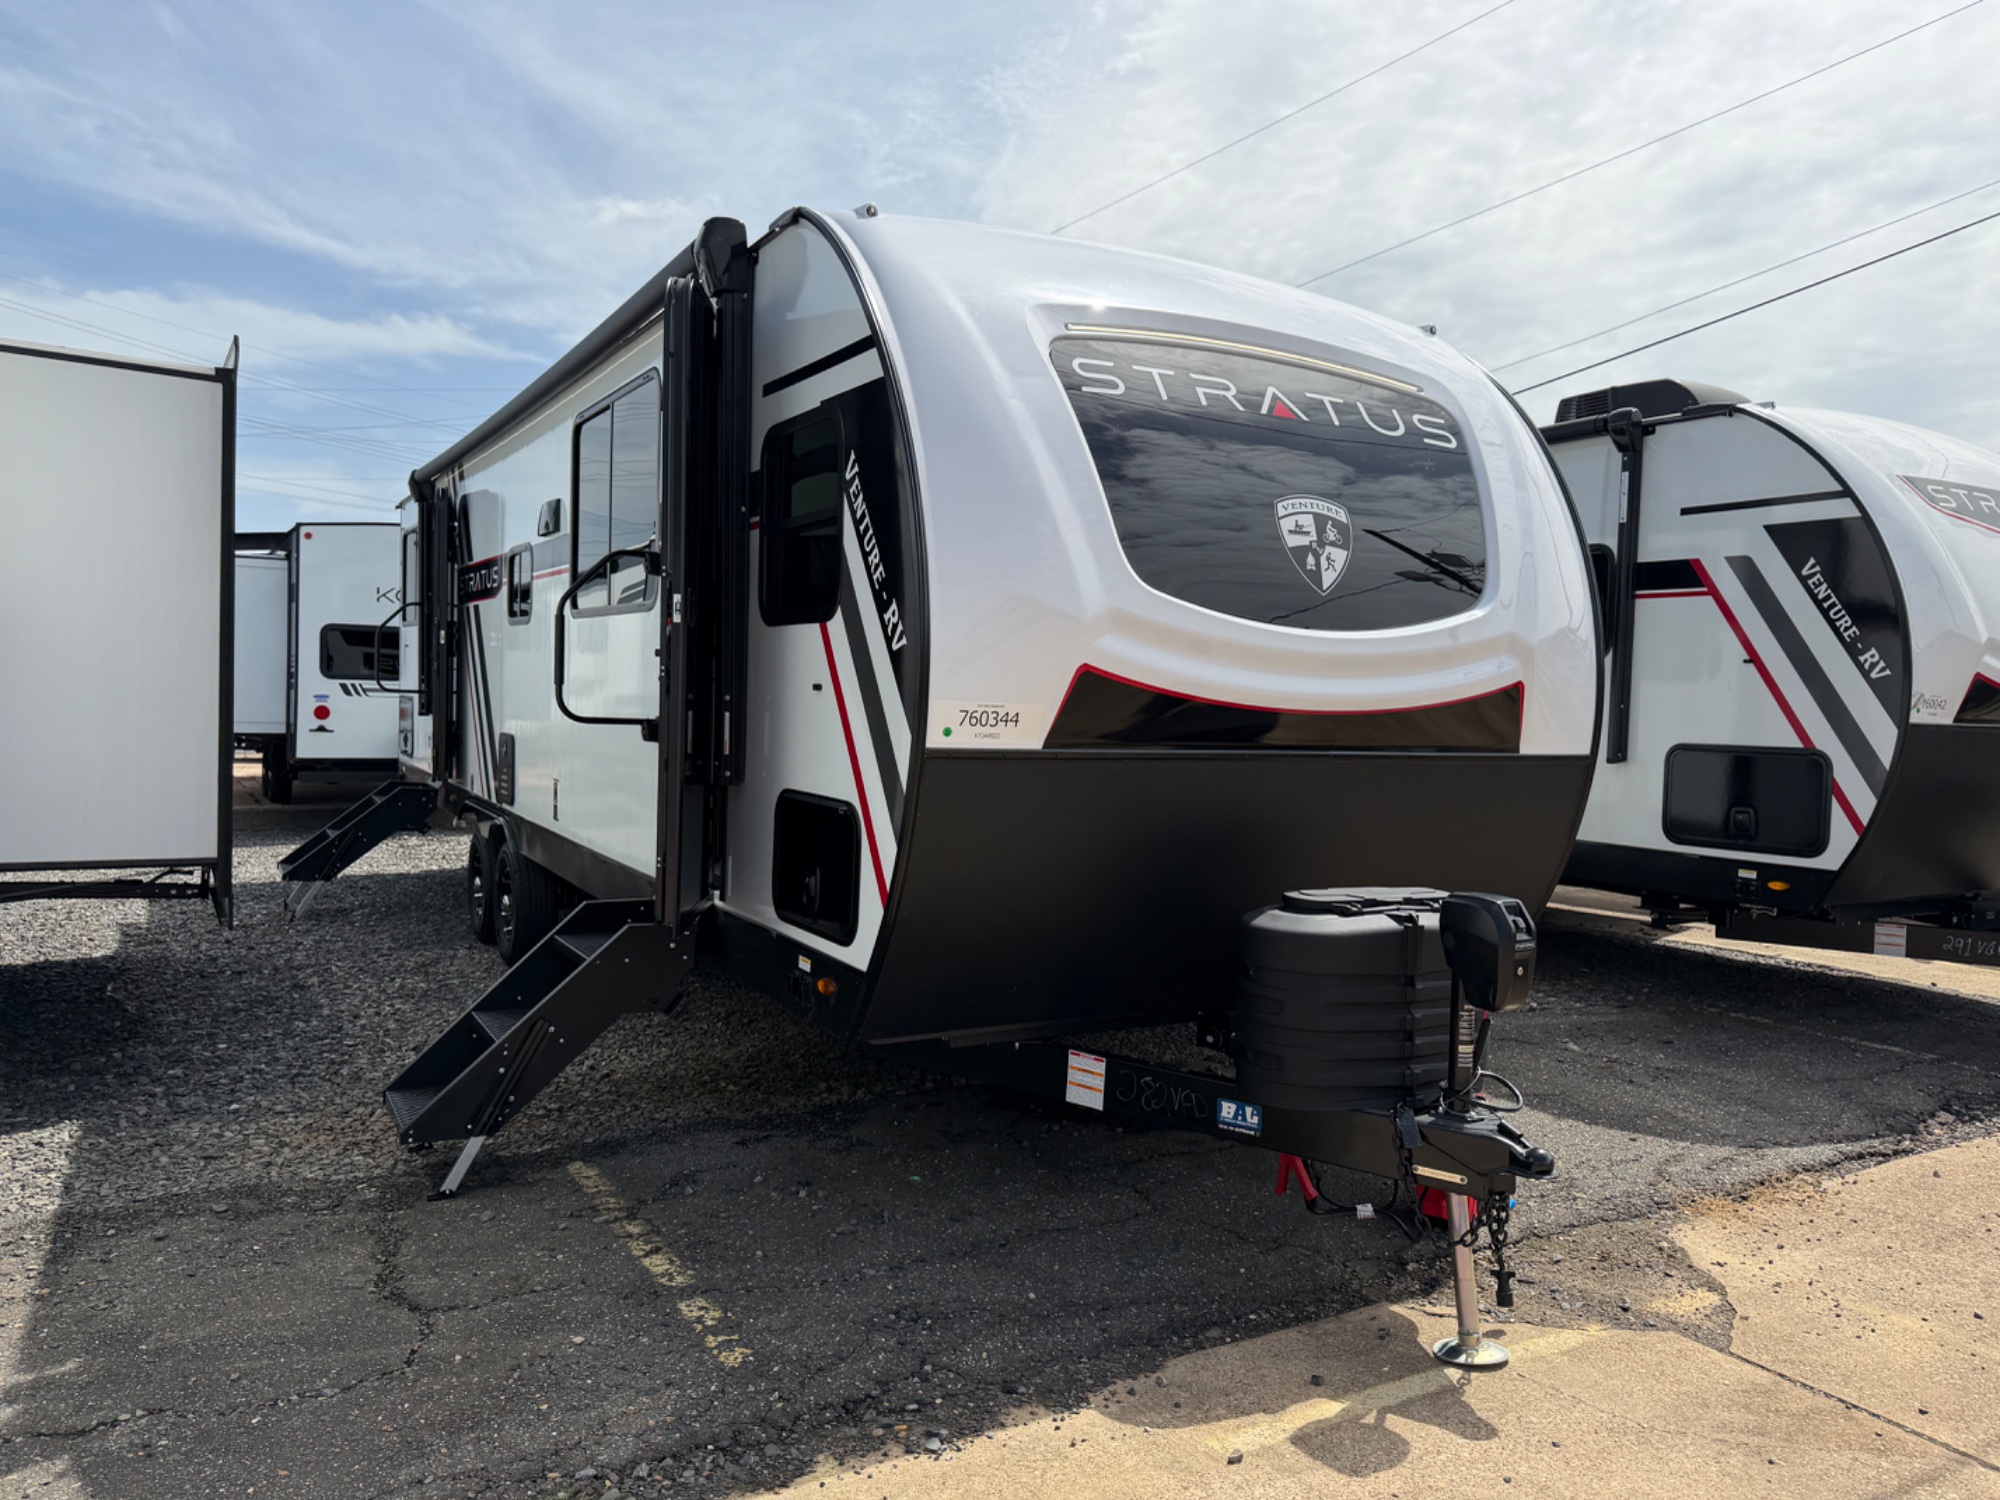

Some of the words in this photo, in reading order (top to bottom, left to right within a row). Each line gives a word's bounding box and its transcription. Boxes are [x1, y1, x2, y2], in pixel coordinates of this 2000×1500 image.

[1072, 357, 1458, 449] STRATUS
[1282, 501, 1343, 519] VENTURE
[883, 598, 907, 652] RV
[1858, 647, 1892, 680] RV
[959, 709, 1020, 728] 760344
[1942, 935, 1973, 957] 291
[1220, 1101, 1259, 1124] BAL
